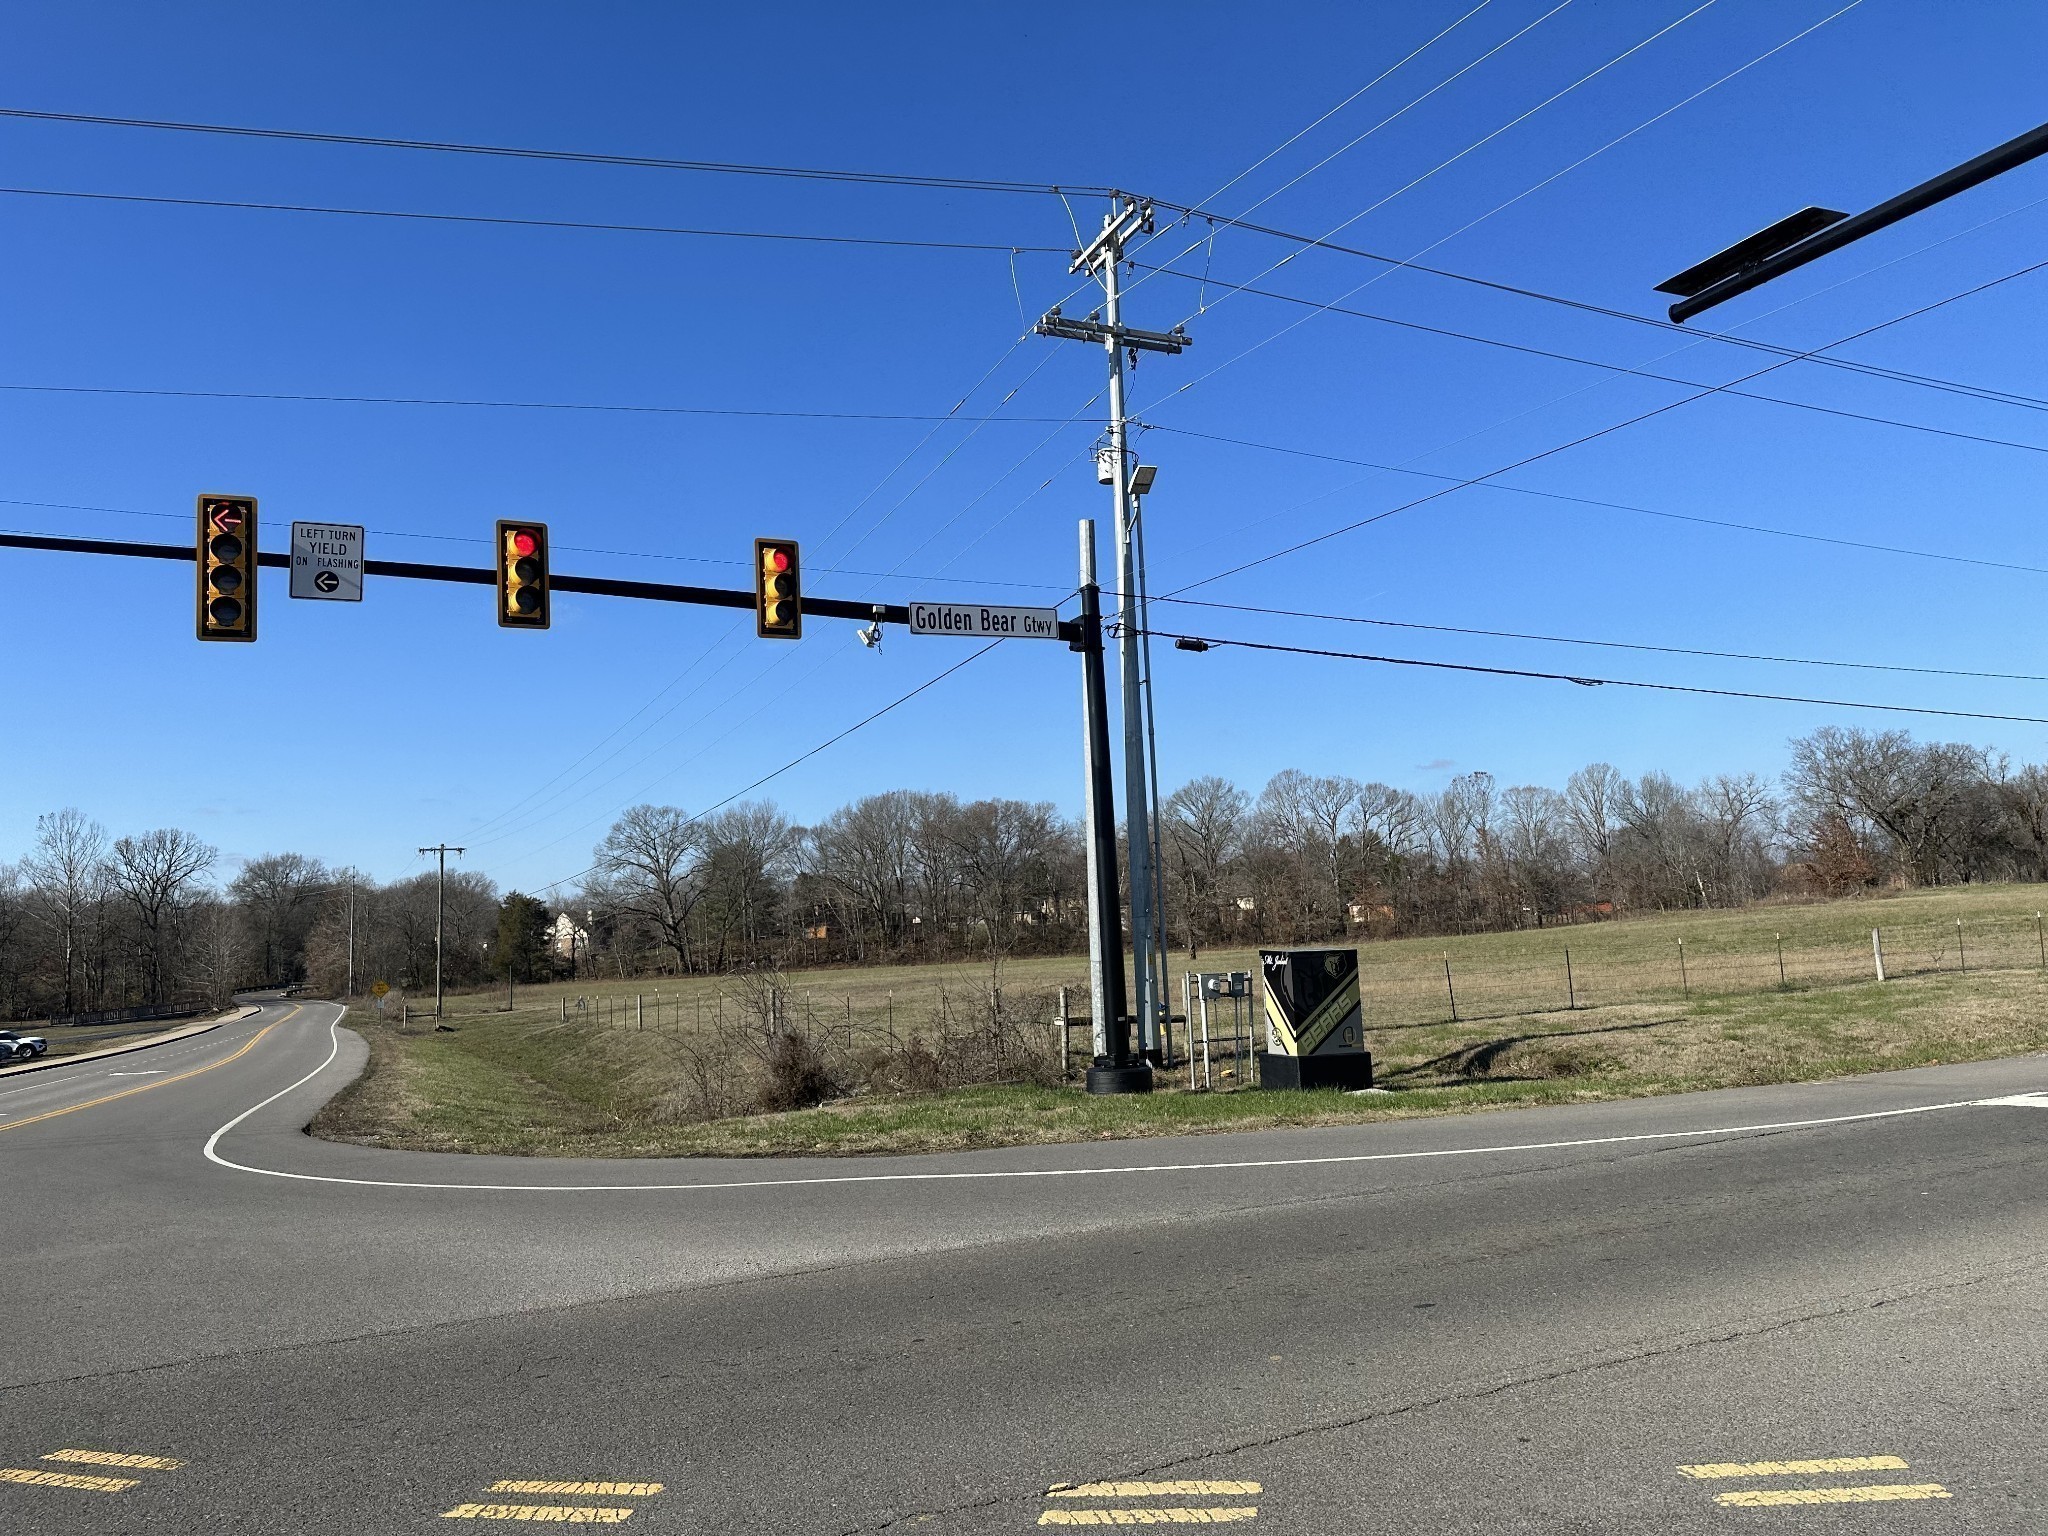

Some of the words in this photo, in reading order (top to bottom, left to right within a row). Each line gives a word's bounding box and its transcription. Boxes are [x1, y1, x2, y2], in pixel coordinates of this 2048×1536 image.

[300, 528, 325, 539] LEFT
[329, 530, 356, 541] TURN
[309, 541, 347, 556] YIELD
[296, 556, 308, 566] ON
[317, 557, 359, 569] FLASHING
[916, 605, 973, 631] Golden
[980, 608, 1017, 632] Bear
[1024, 615, 1052, 636] Gtwy
[1300, 992, 1352, 1050] BEARS
